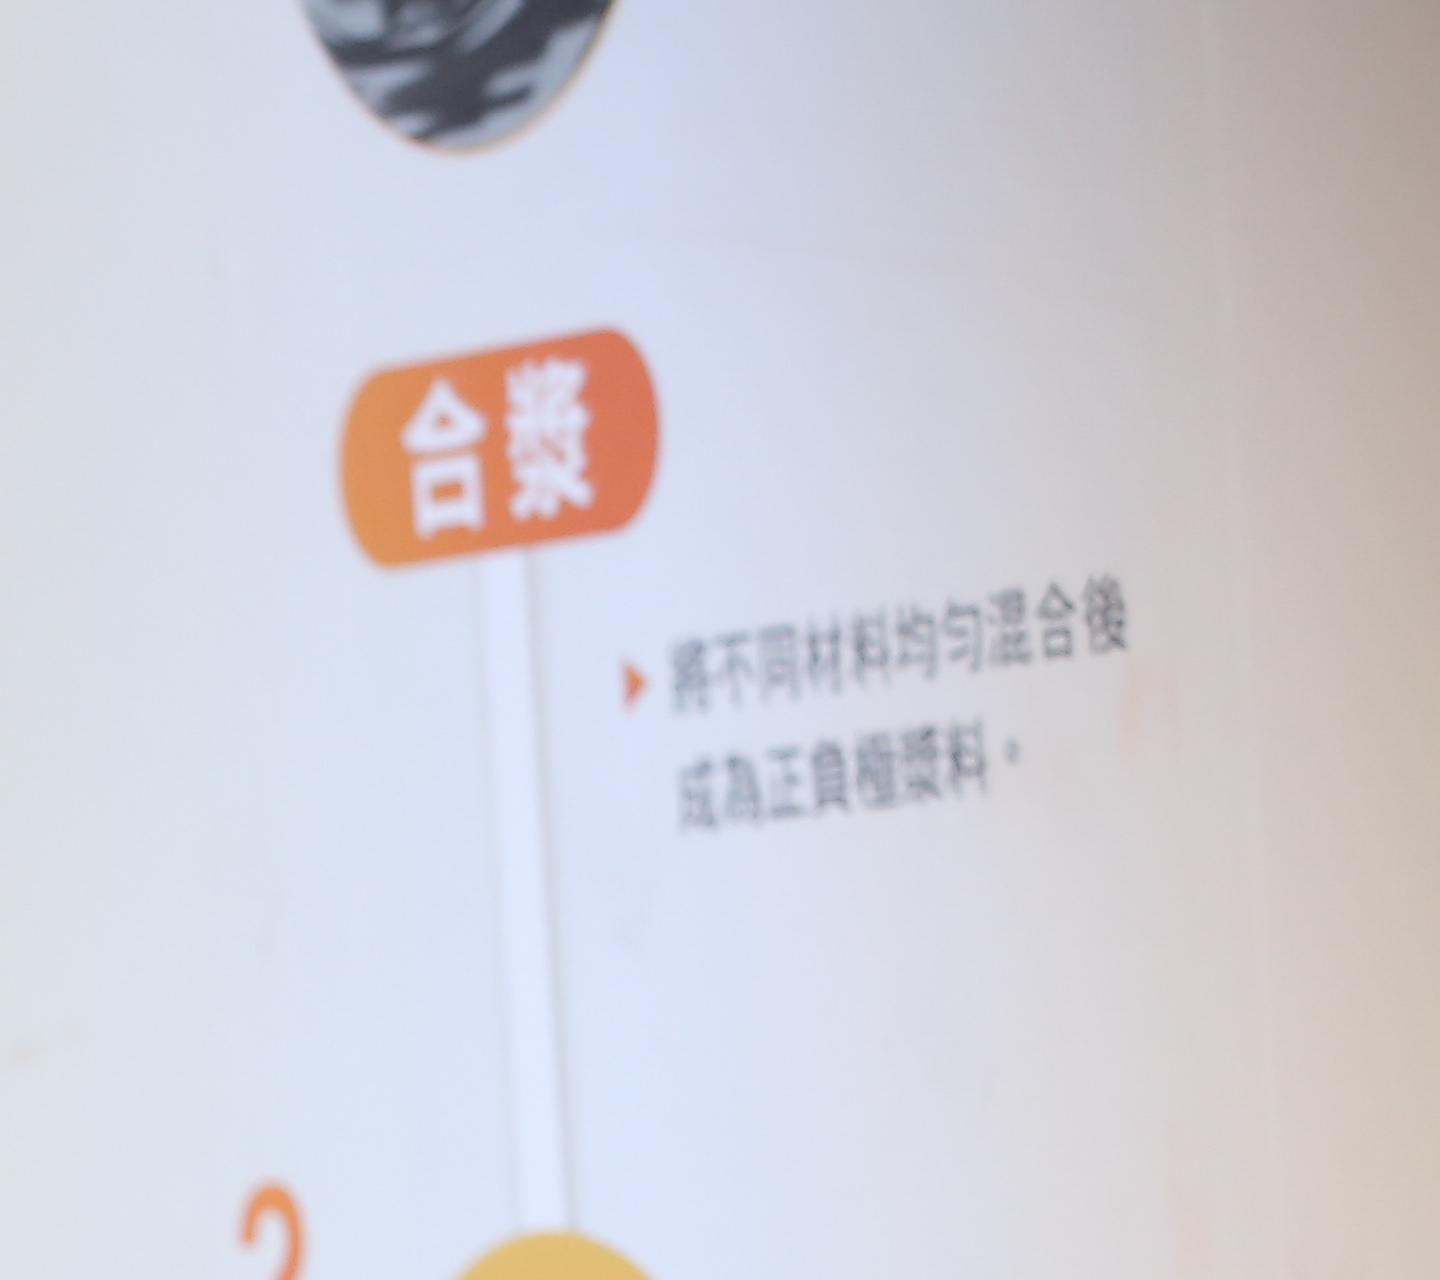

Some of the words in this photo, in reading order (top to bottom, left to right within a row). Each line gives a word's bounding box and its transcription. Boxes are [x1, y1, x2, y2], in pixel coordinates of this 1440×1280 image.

[670, 574, 1128, 714] 將不同材料均勻混合後
